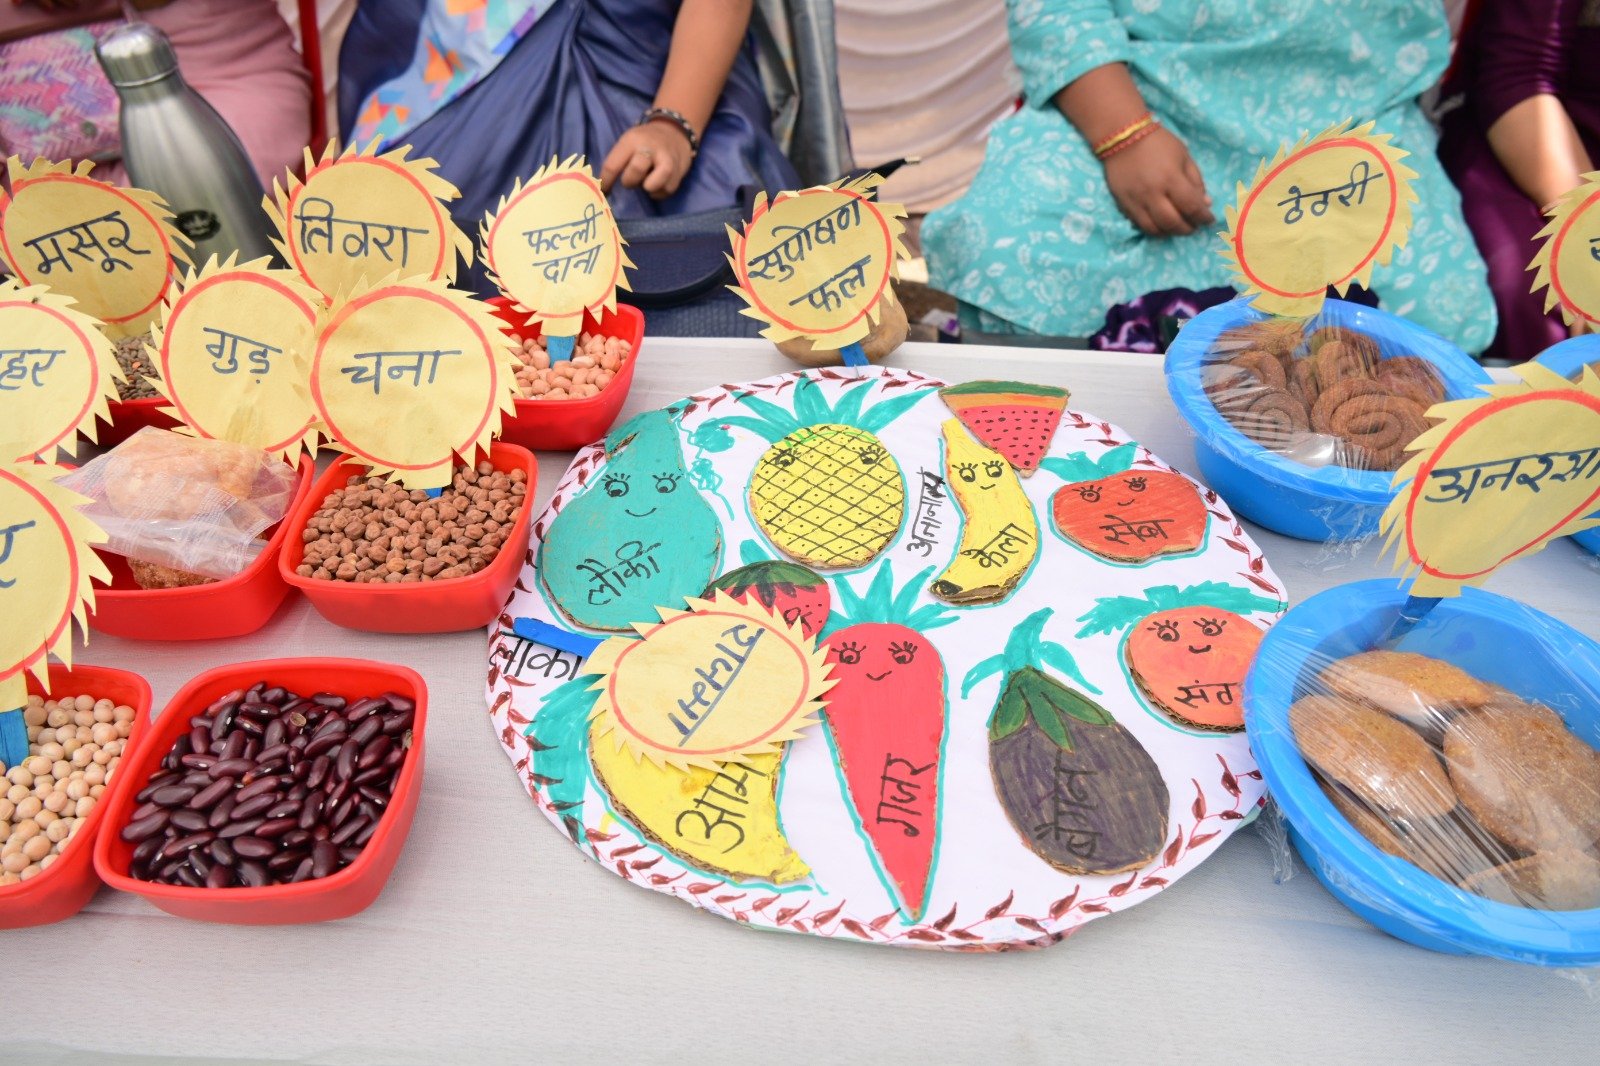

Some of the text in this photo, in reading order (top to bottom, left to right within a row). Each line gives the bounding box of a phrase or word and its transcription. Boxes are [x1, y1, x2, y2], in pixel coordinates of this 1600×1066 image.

[1277, 161, 1384, 224] ठेठरी
[24, 210, 151, 274] मसूर
[294, 197, 429, 268] तिवरा
[522, 203, 603, 254] फल्ली
[748, 196, 862, 283] सुपोषण
[532, 243, 604, 283] दाना
[788, 254, 871, 312] फल
[341, 349, 462, 394] चना
[960, 523, 1034, 568] केला
[1099, 514, 1174, 545] सेब
[668, 624, 766, 747] राजमा
[676, 761, 766, 855] आम
[876, 753, 936, 838] गाजर
